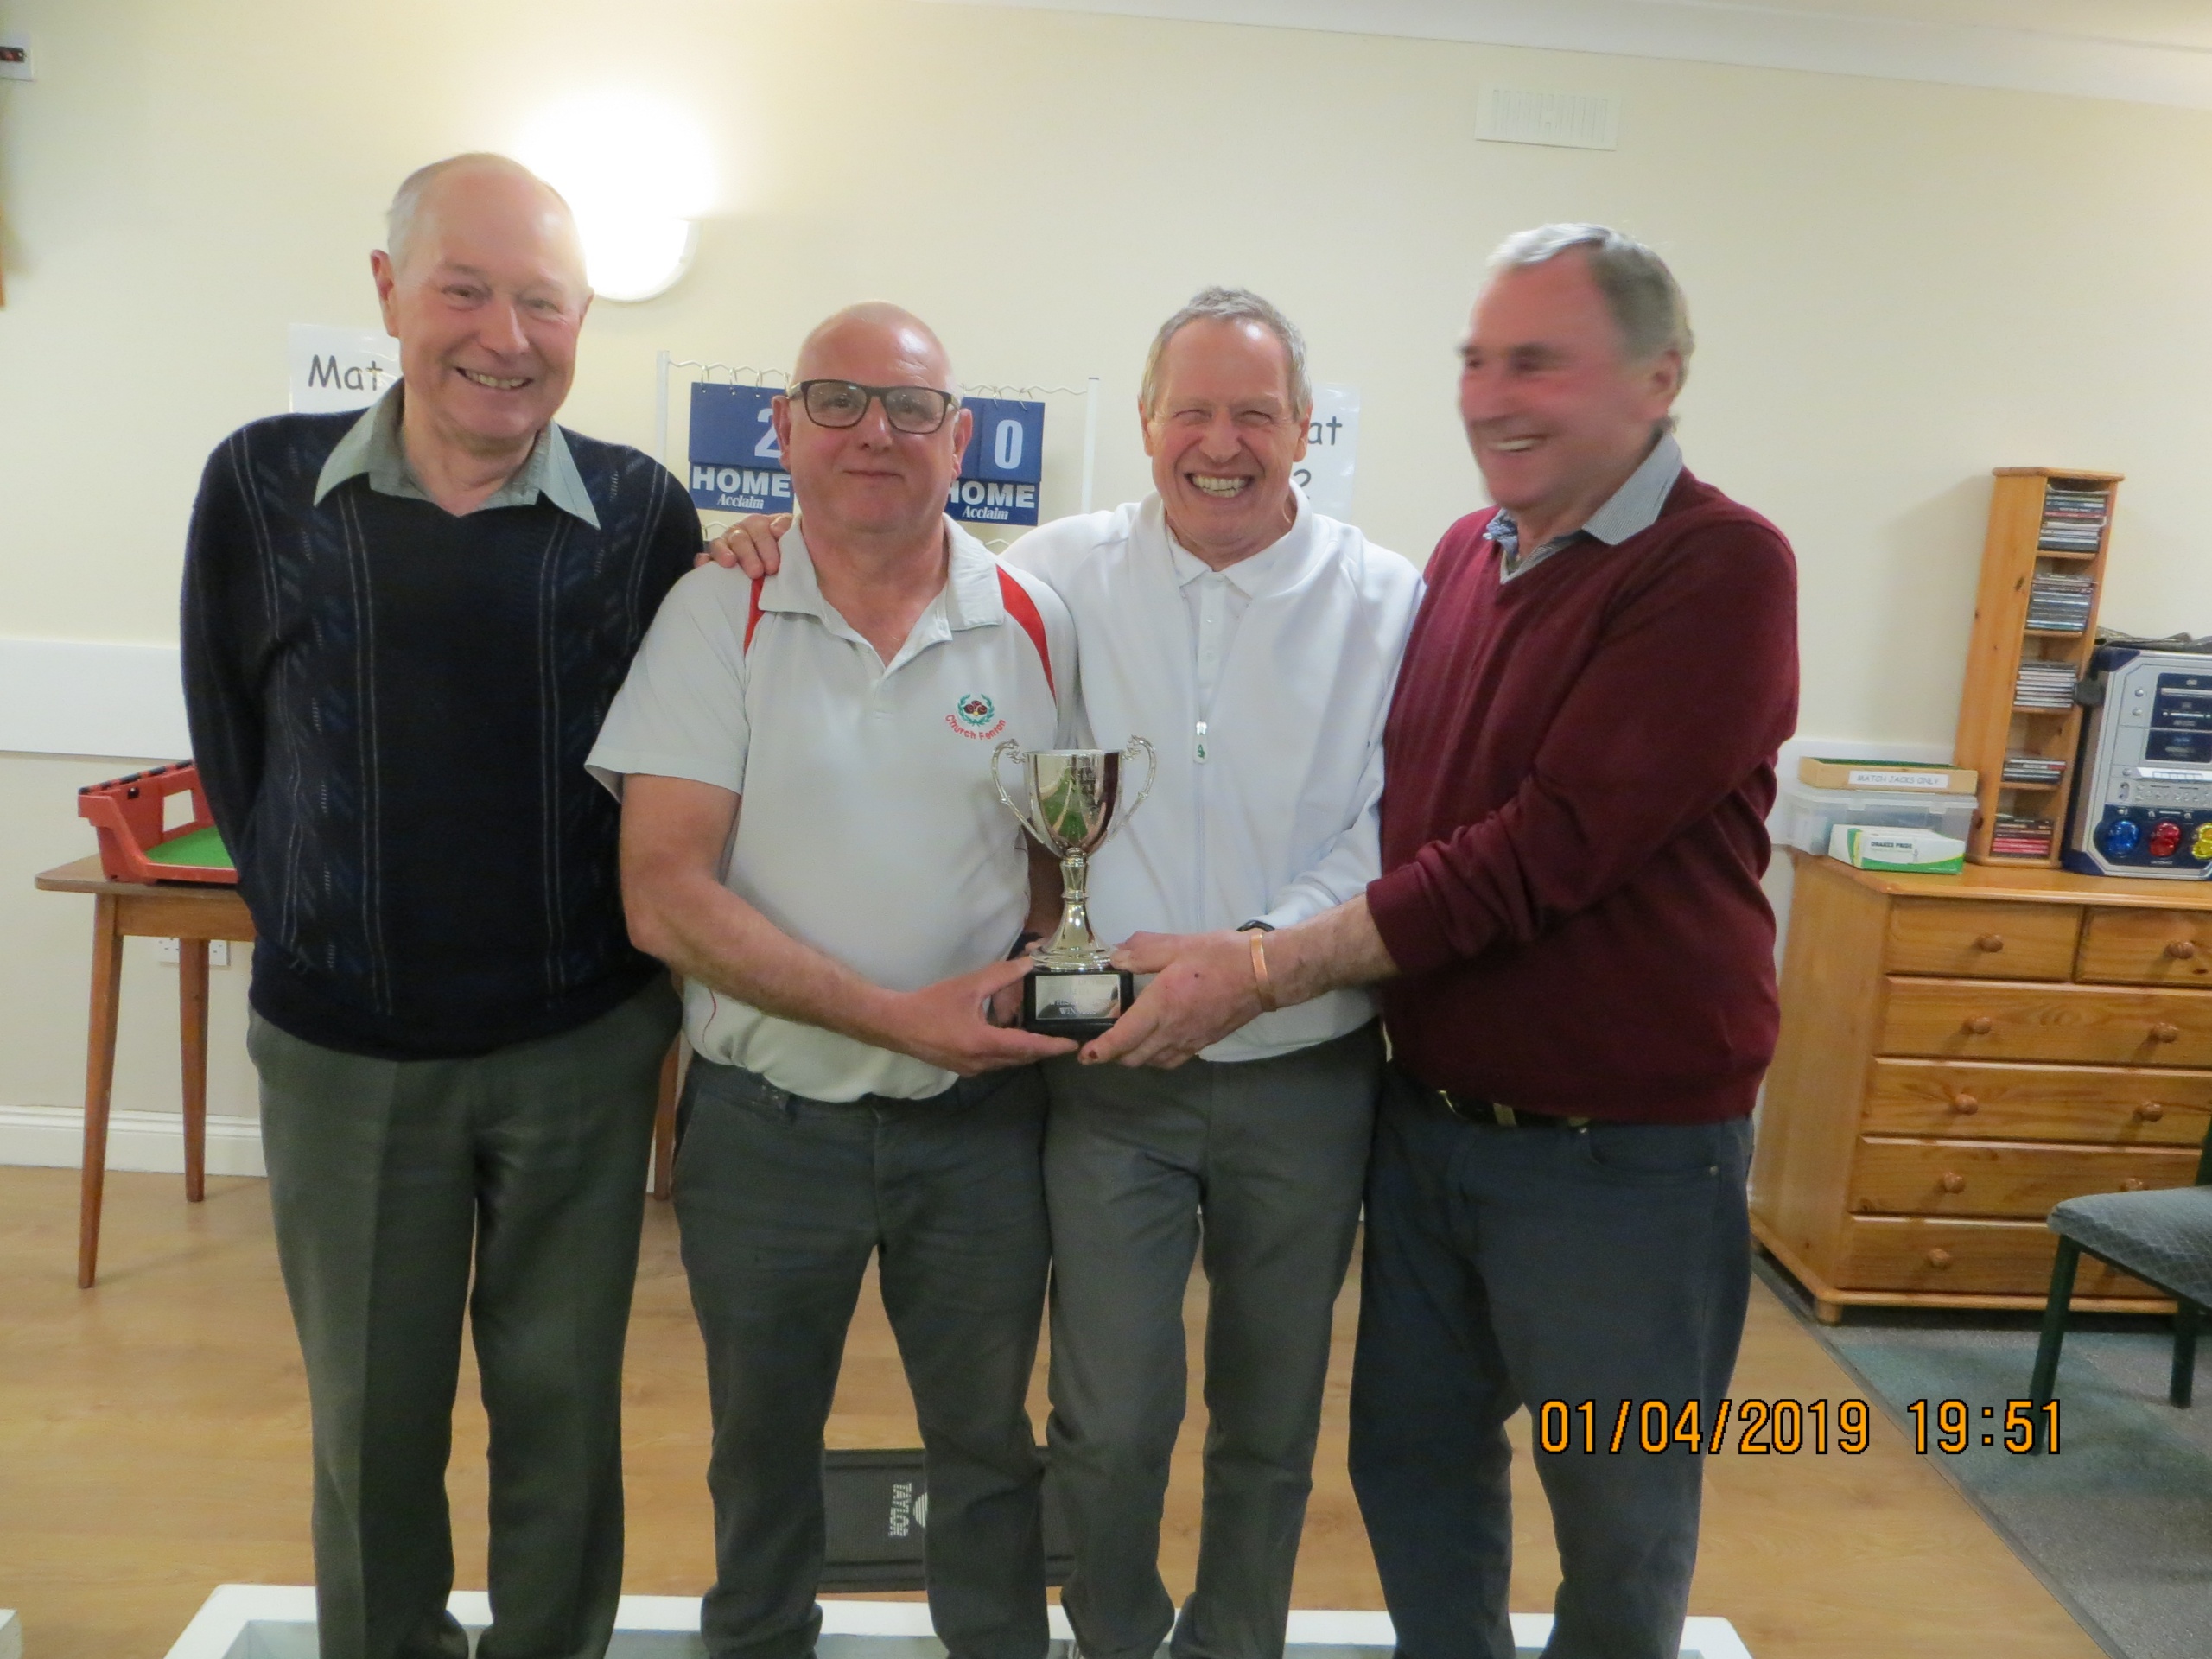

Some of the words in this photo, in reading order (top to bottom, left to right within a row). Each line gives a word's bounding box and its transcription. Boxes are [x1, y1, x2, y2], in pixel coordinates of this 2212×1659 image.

[308, 354, 383, 391] Mat
[754, 408, 784, 459] 2
[995, 419, 1023, 469] 0
[1307, 416, 1343, 446] at
[692, 466, 791, 498] HOME
[717, 493, 765, 510] Acclaim
[962, 505, 1009, 520] Acclaim
[945, 714, 976, 740] Church
[978, 719, 1007, 740] Fenton
[1857, 774, 1886, 783] MATCH
[887, 1482, 912, 1537] TAYLOR
